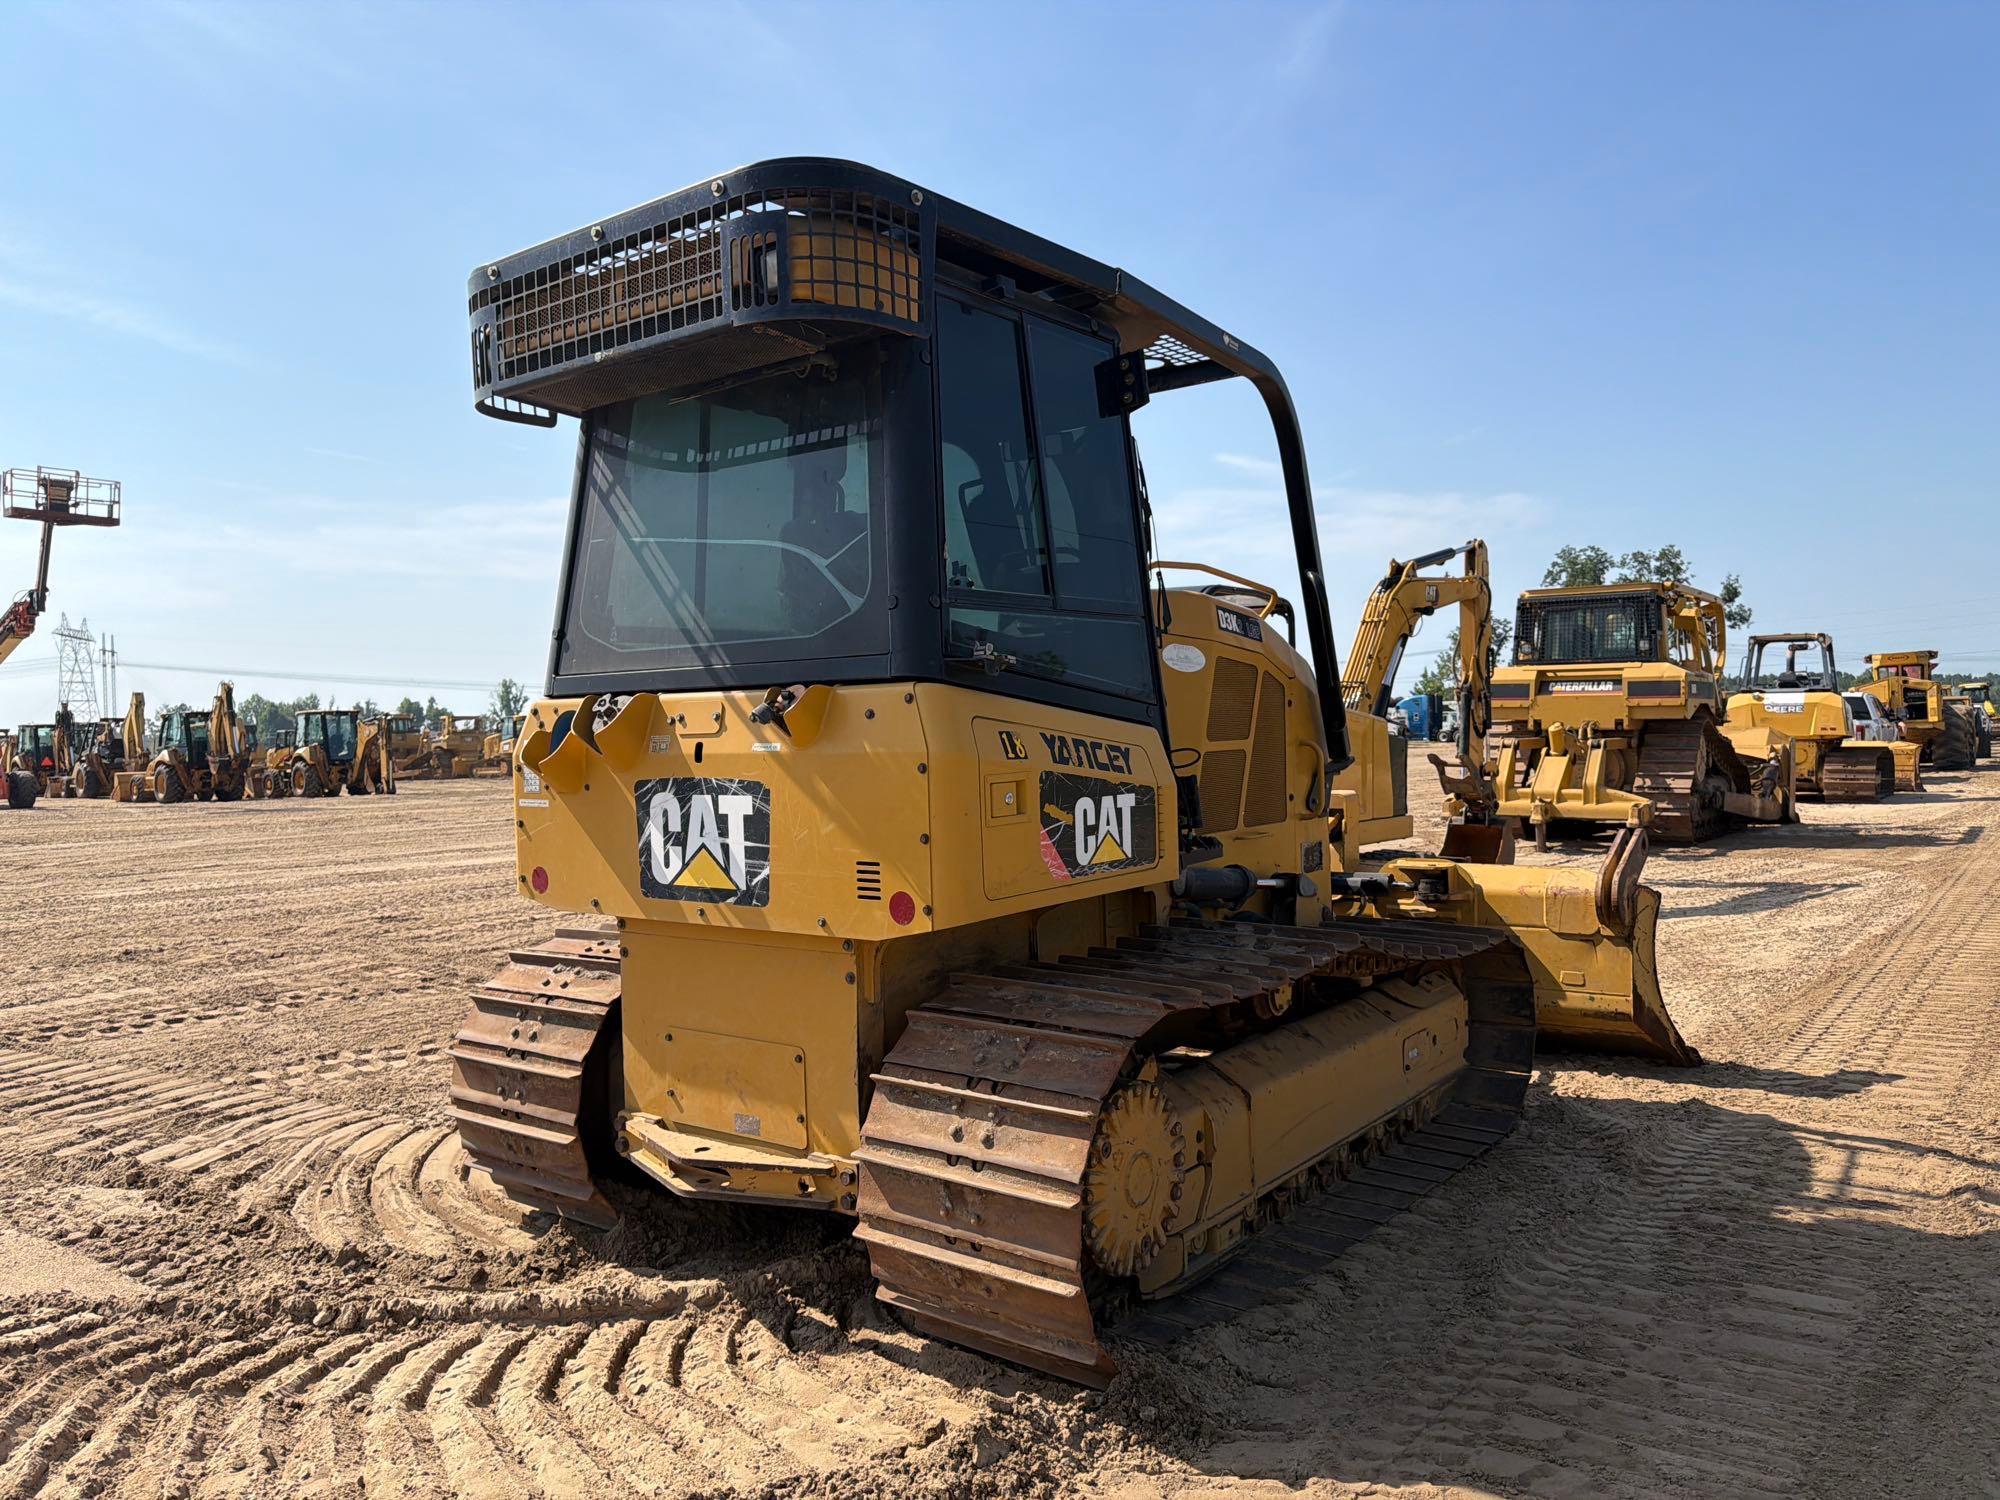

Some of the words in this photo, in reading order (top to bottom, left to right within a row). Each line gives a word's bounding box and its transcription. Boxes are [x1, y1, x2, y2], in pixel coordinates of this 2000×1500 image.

[1548, 681, 1614, 692] CATERPILLAR
[1002, 732, 1026, 759] 18
[1039, 732, 1133, 775] YANCEY
[650, 791, 753, 891] CAT
[1074, 792, 1136, 866] CAT
